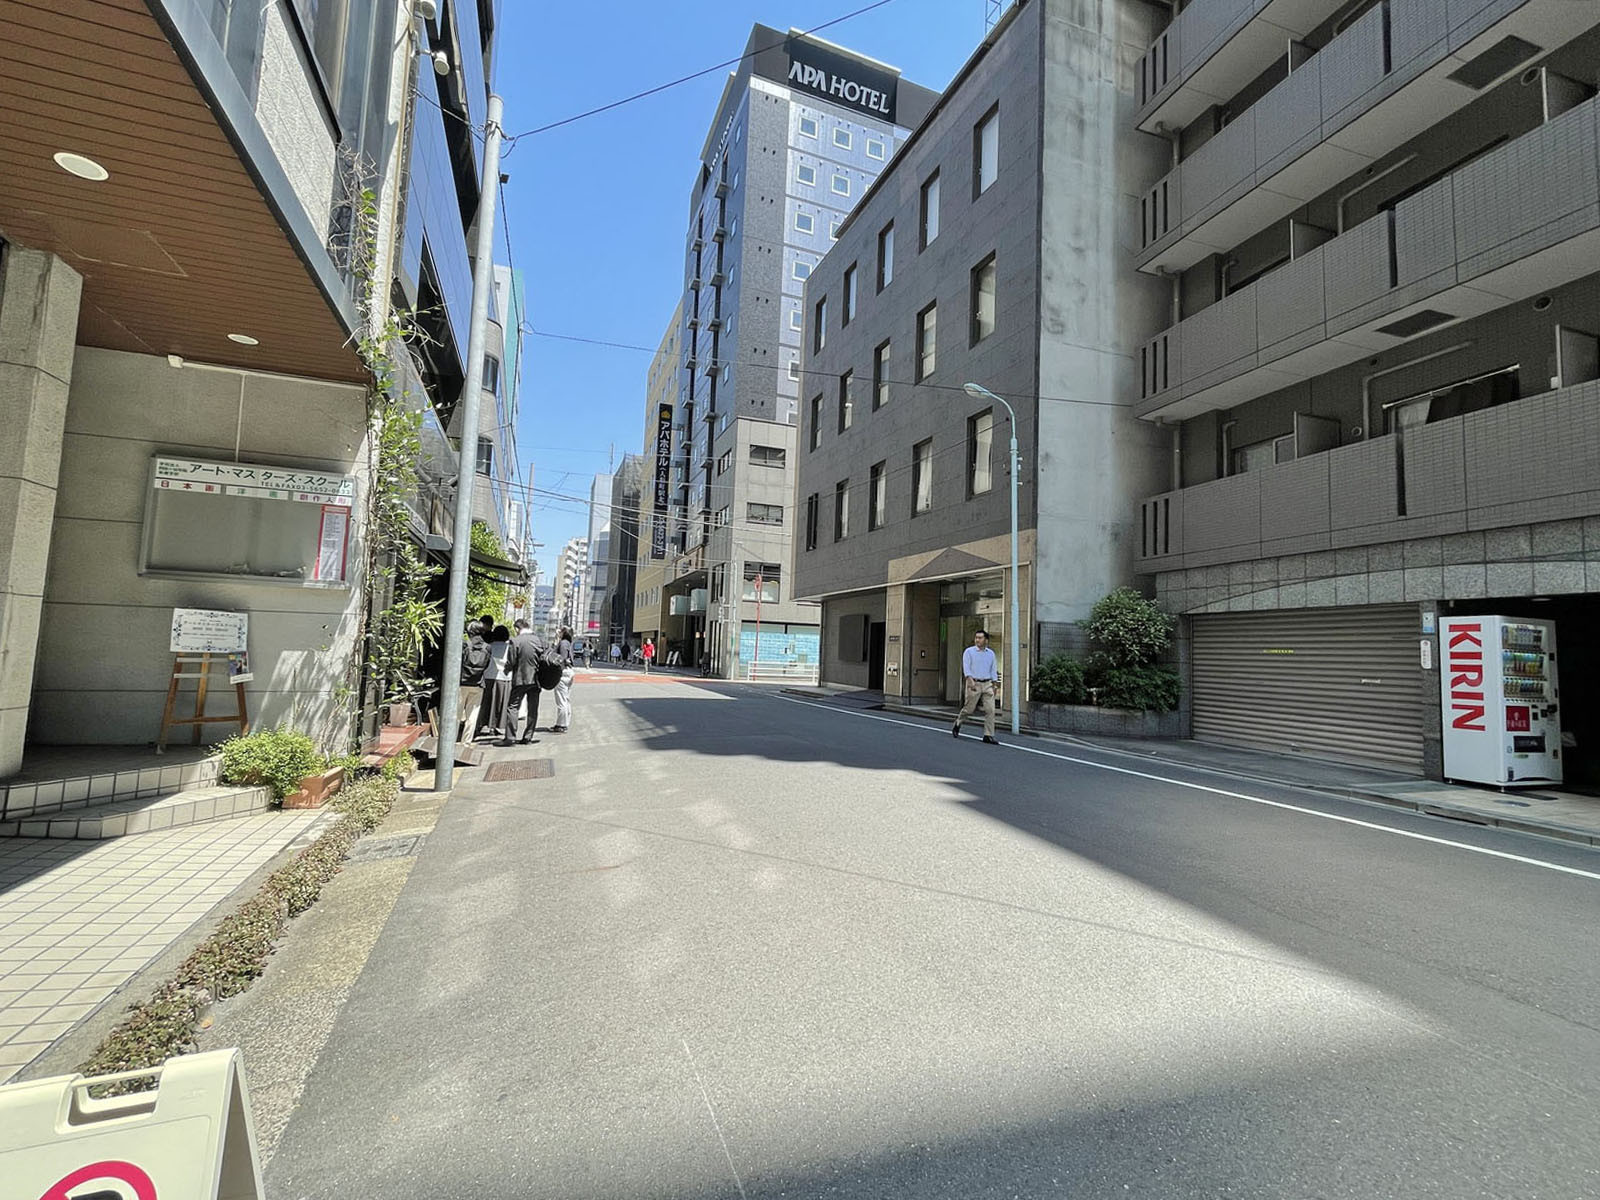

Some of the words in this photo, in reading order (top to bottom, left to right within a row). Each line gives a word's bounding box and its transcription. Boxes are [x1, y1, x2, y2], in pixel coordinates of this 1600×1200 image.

[788, 61, 827, 92] APA
[829, 75, 890, 114] HOTEL
[1448, 623, 1486, 732] KIRIN
